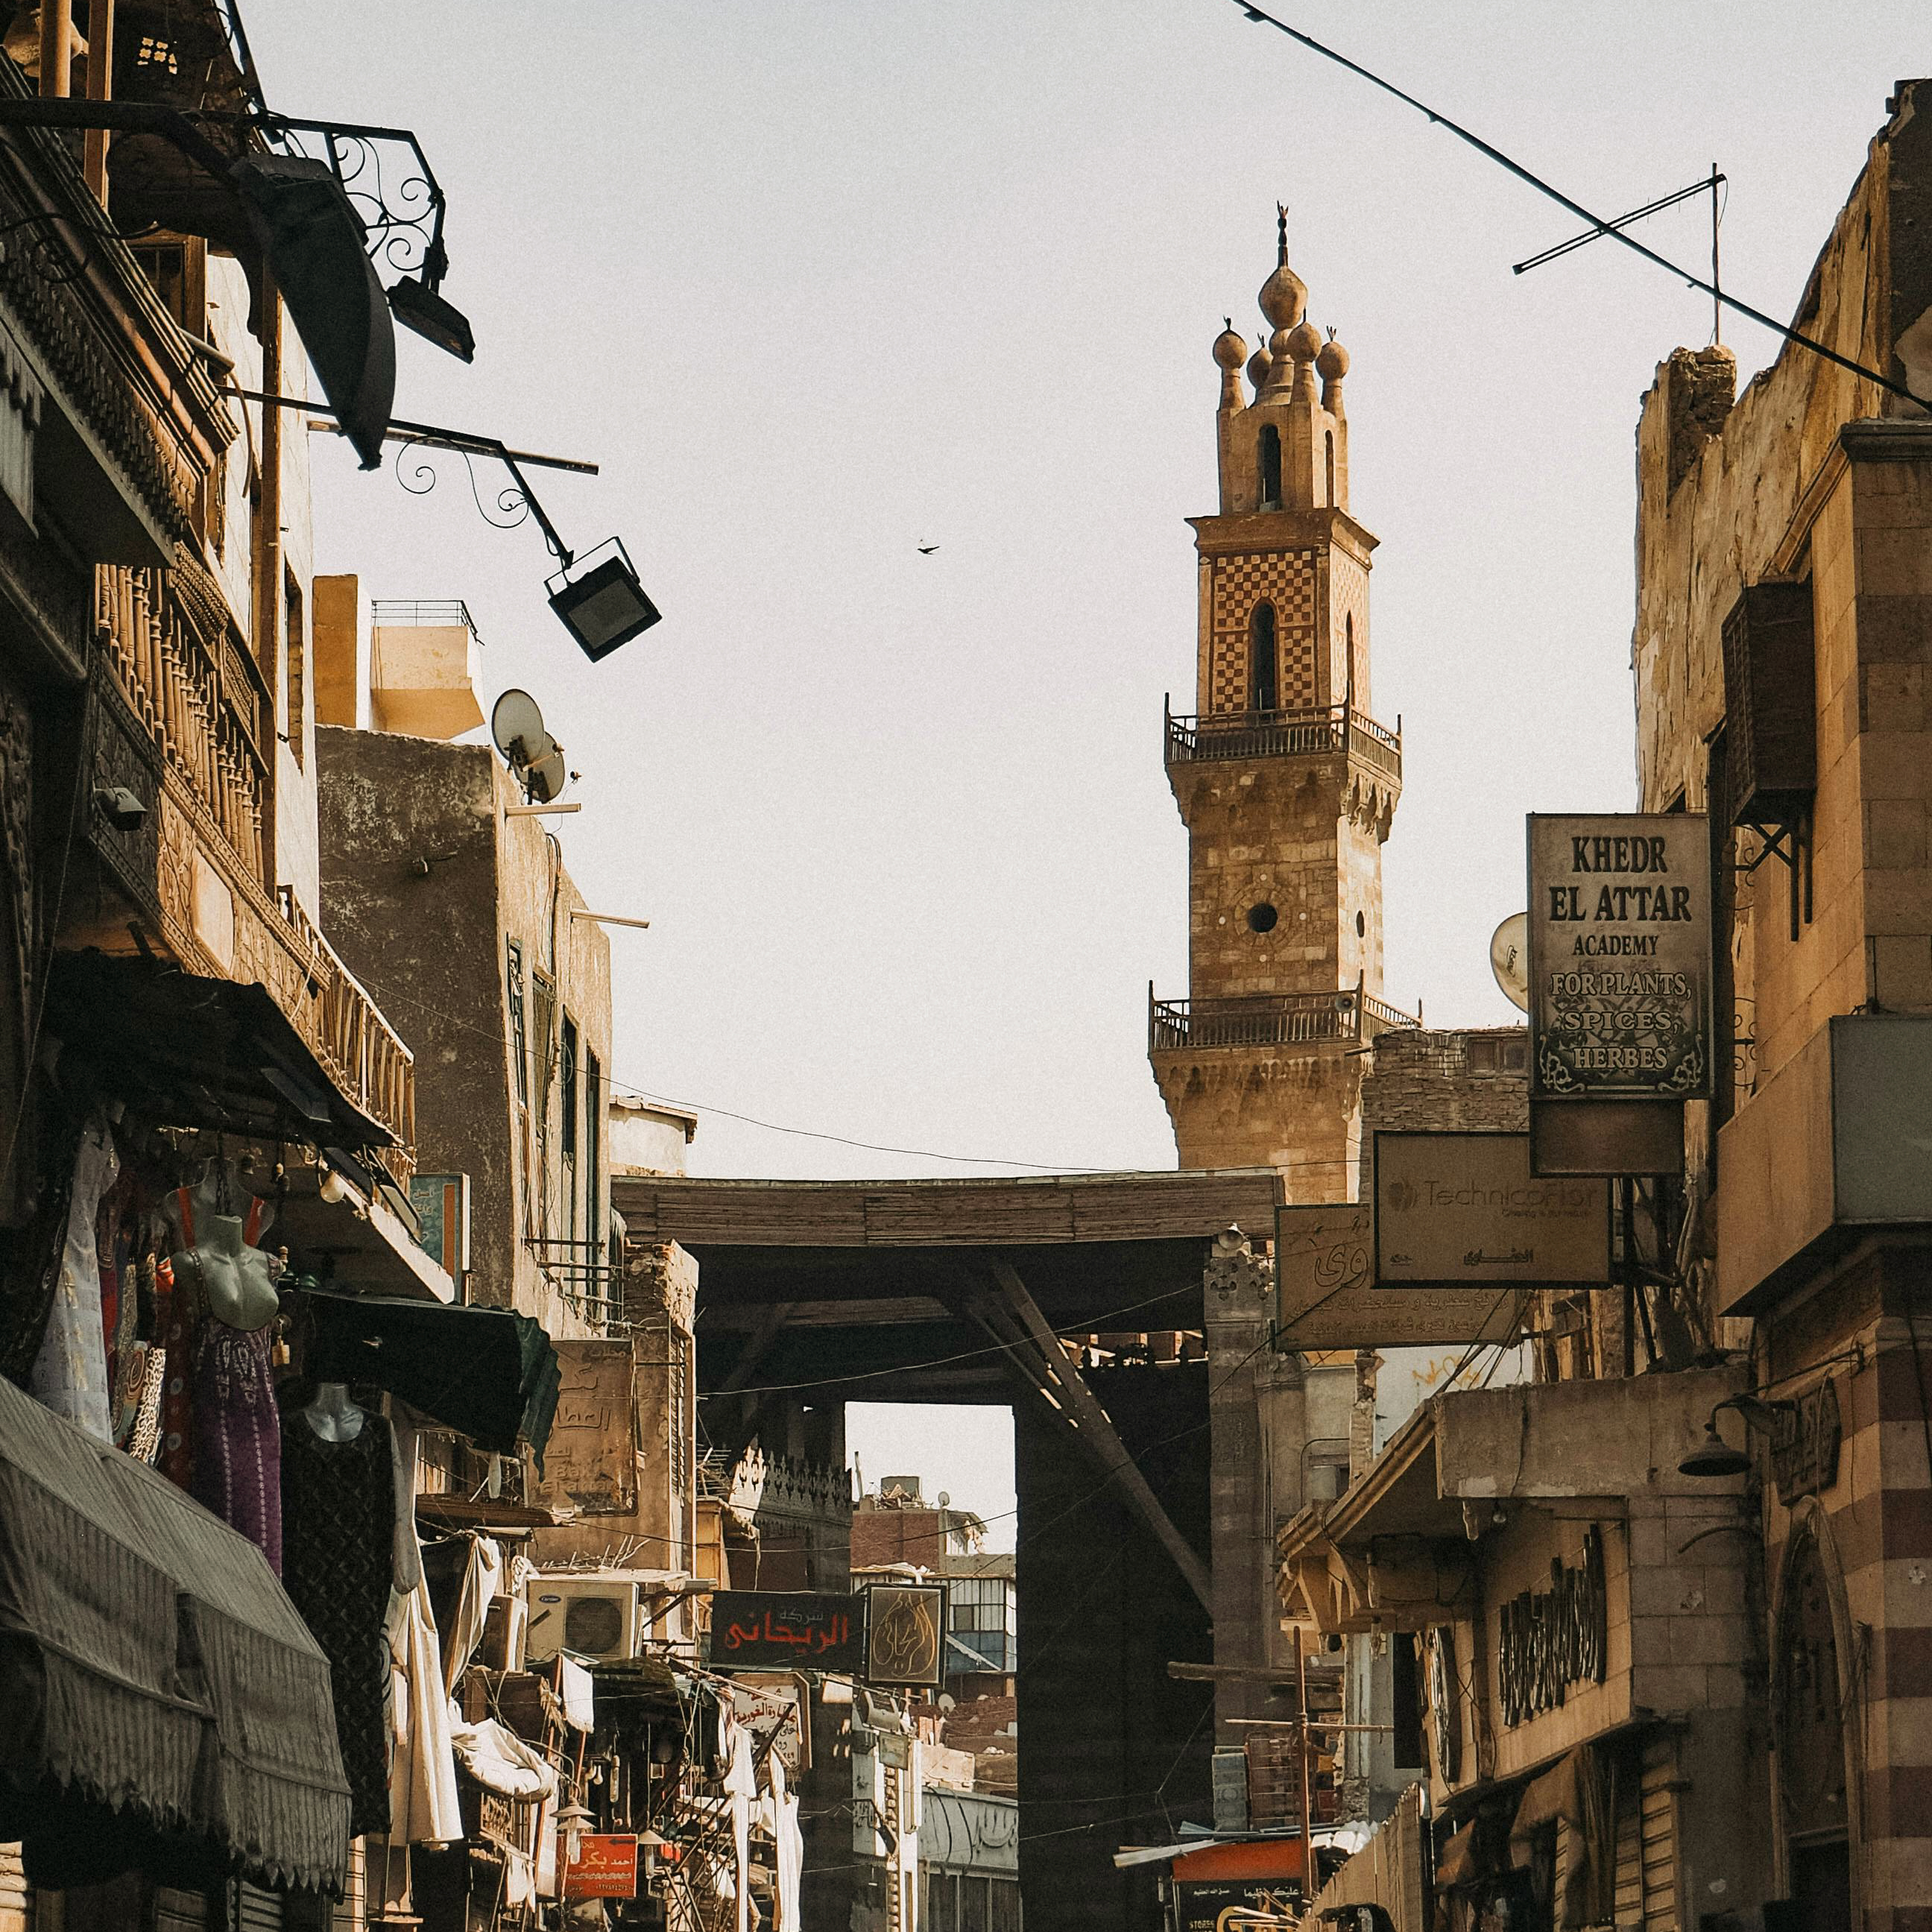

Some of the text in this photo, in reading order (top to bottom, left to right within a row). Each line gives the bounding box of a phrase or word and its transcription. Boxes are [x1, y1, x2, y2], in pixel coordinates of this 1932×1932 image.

[1571, 836, 1667, 873] KHEDR
[1549, 885, 1692, 922] EL ATTAR
[1572, 935, 1659, 956] ACADEMY
[1550, 972, 1692, 1000] FOR PLANTS,
[1563, 1011, 1680, 1035] SPICES,
[1573, 1047, 1668, 1070] HERBES
[579, 1851, 634, 1869] أحمد بكر
